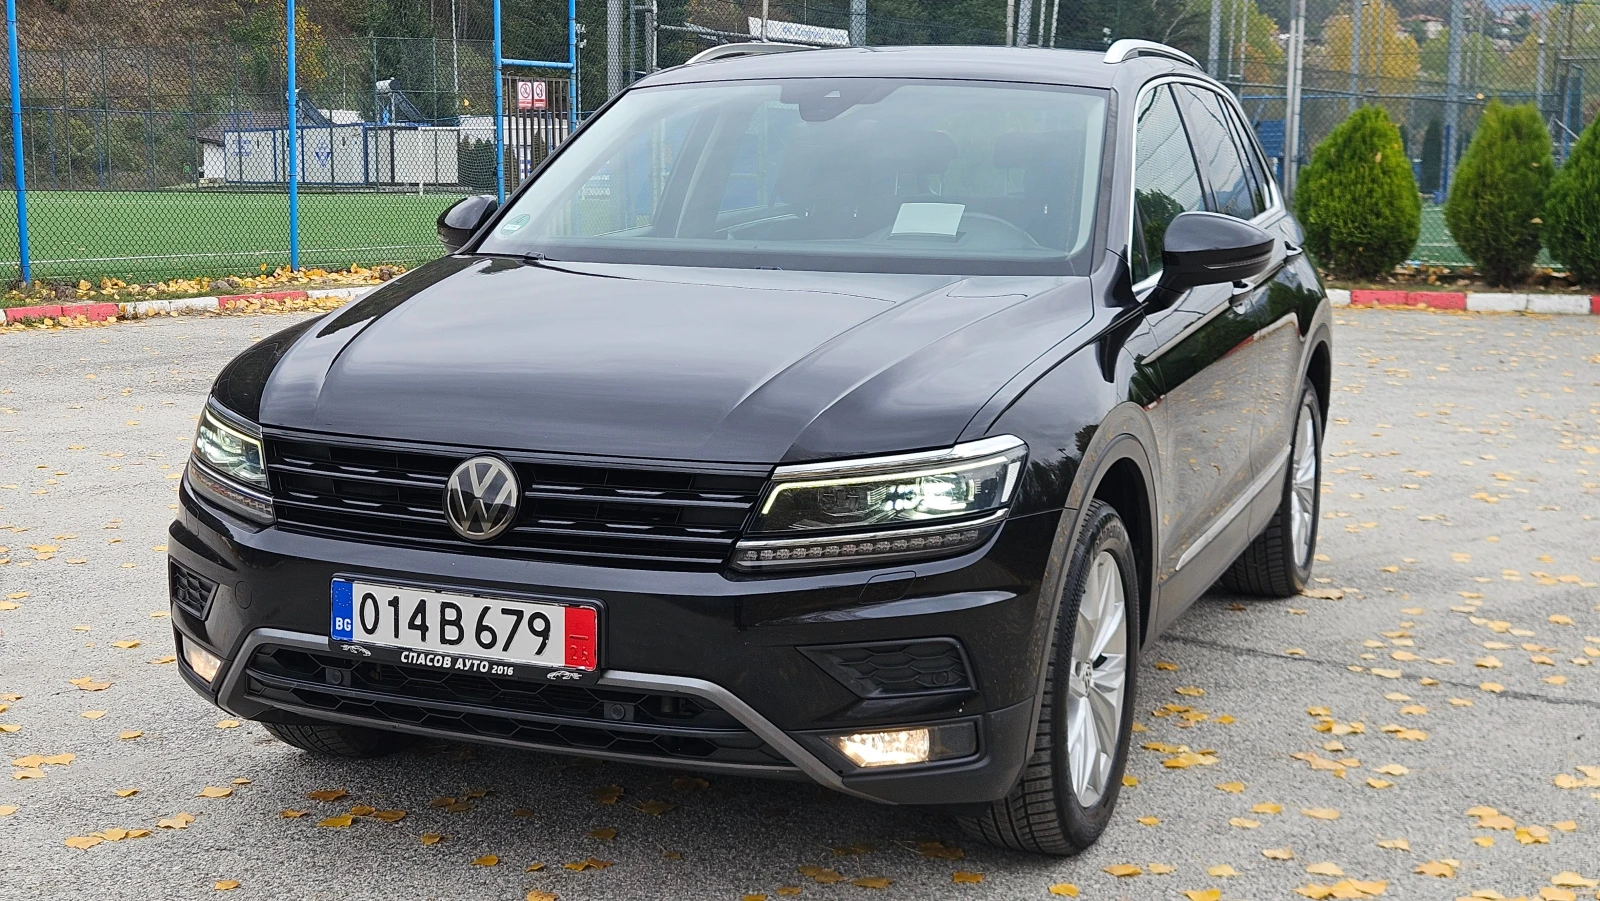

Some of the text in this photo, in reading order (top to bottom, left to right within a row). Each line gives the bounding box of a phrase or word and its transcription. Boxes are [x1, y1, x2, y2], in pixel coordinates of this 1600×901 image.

[335, 618, 352, 632] BG
[400, 651, 514, 676] СПАСОВ АУТО 2016
